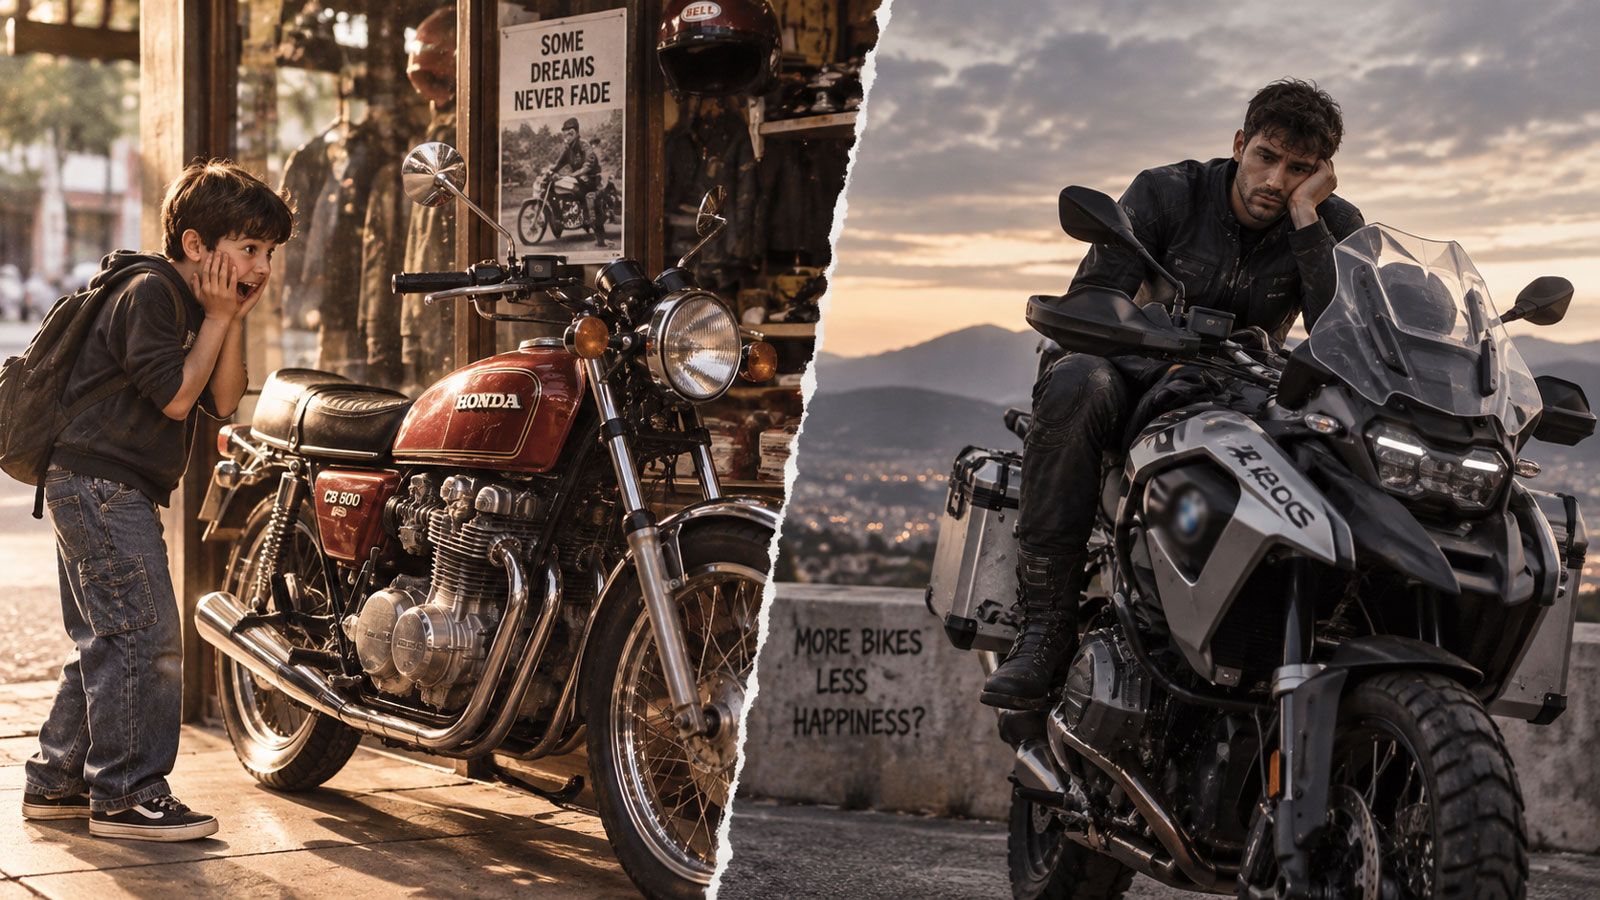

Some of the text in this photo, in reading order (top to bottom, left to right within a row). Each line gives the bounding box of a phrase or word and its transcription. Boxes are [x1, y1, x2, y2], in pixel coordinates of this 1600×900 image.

[686, 6, 713, 17] BELL
[541, 30, 584, 56] SOME
[531, 56, 595, 83] DREAMS
[514, 81, 611, 111] NEVER FADE
[455, 393, 522, 411] HONDA
[324, 490, 338, 504] CB
[794, 628, 923, 656] MORE BIKES
[816, 668, 868, 695] LESS
[793, 706, 926, 738] HAPPINESS?
